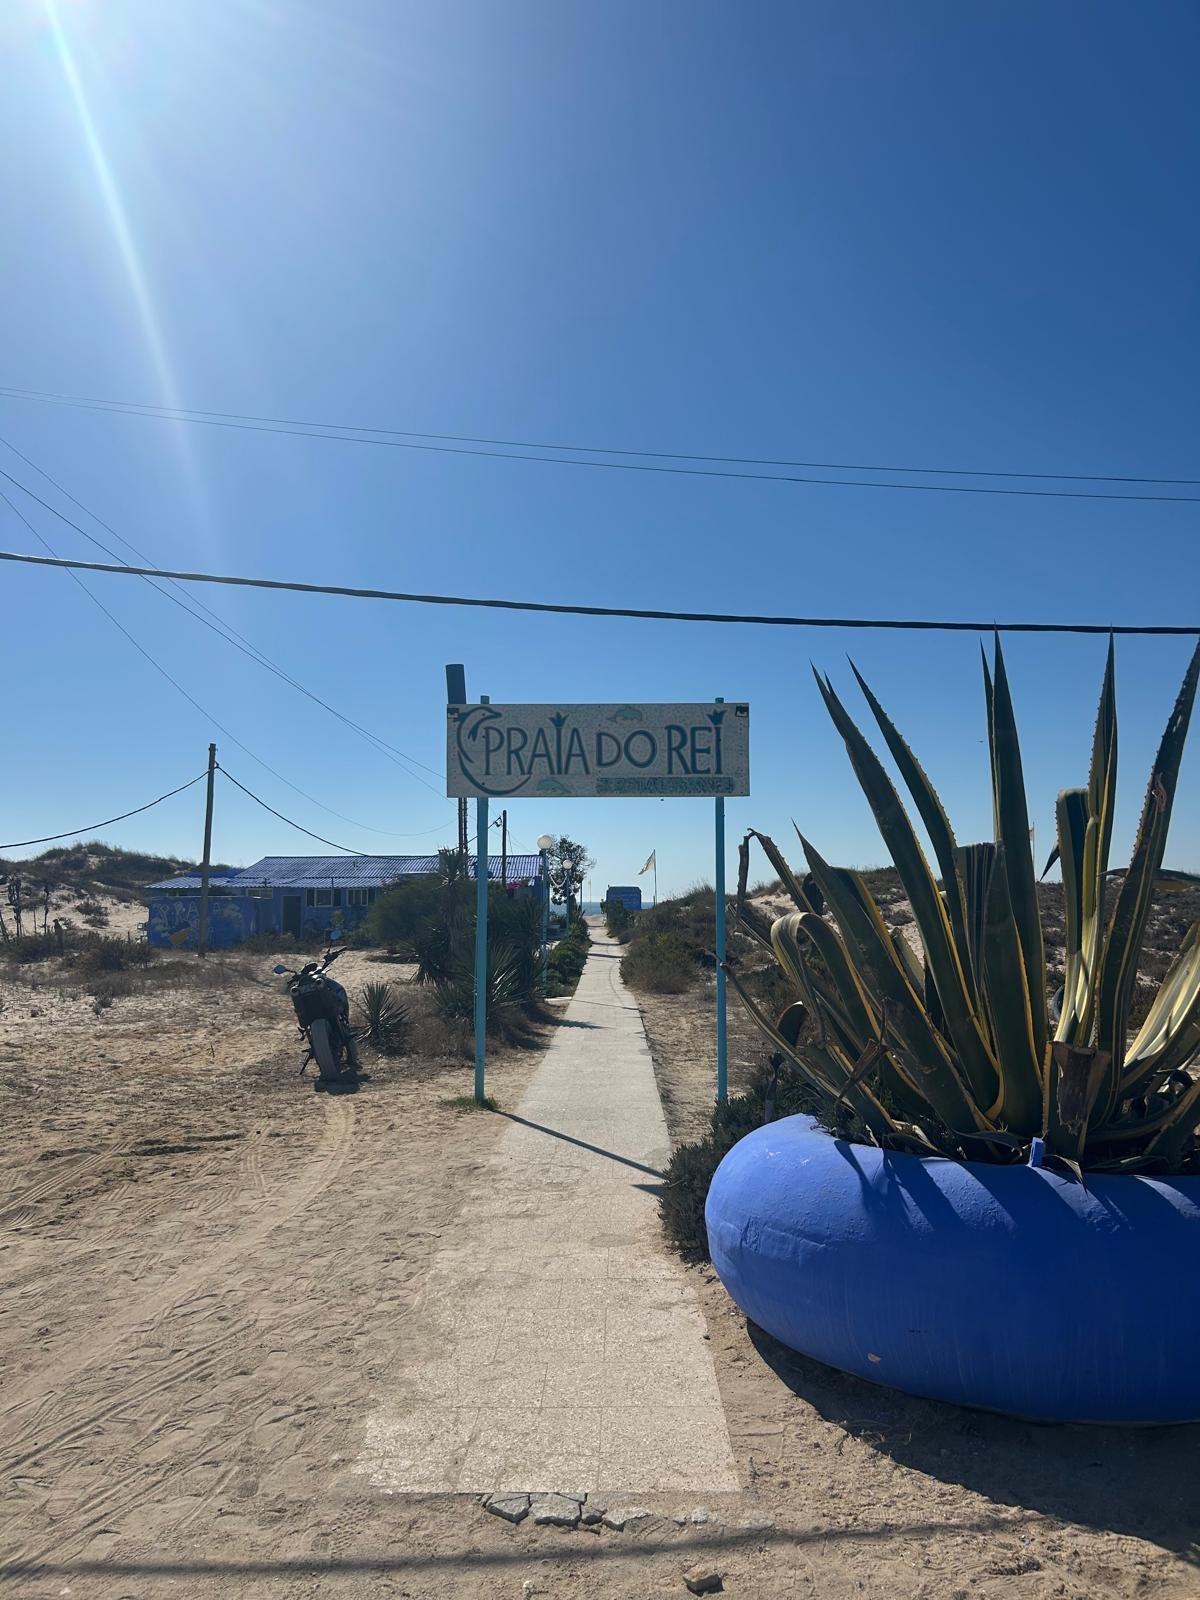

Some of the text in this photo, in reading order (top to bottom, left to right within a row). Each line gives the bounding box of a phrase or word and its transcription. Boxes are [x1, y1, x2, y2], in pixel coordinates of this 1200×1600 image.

[484, 709, 727, 775] PRAIA DO REI
